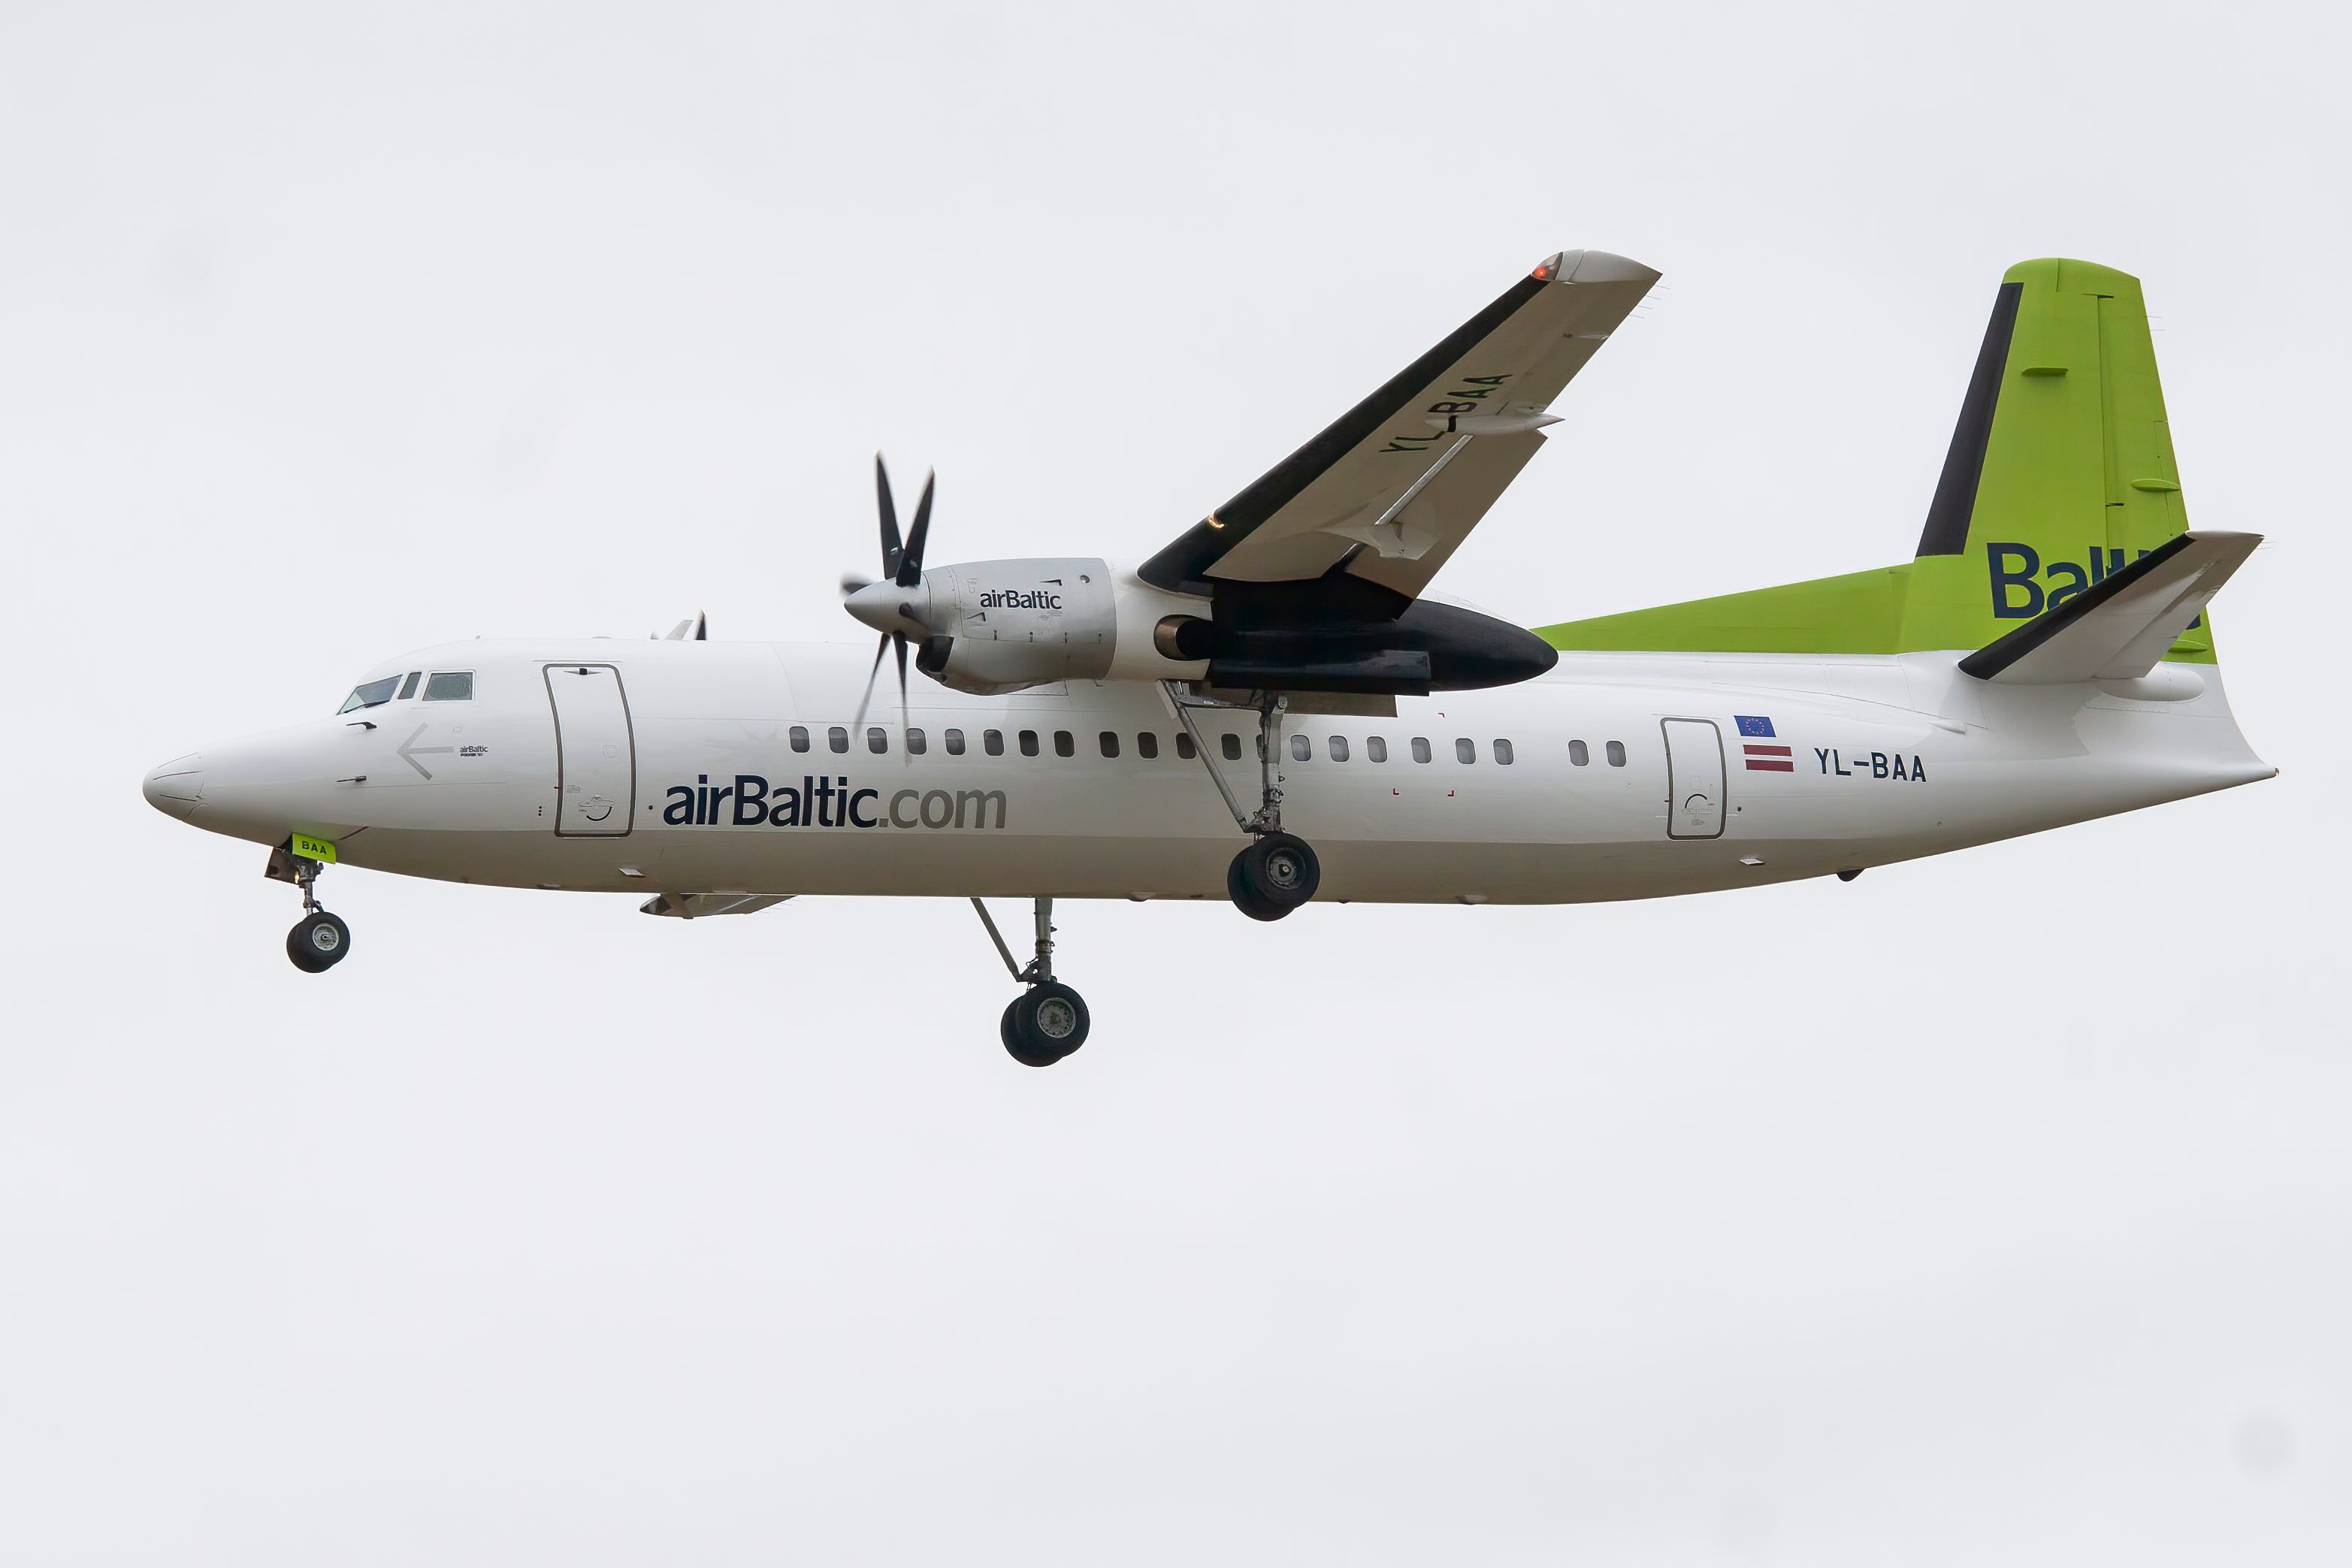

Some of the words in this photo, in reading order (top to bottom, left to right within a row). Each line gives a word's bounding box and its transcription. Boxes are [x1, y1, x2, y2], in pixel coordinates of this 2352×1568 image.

[1379, 374, 1513, 452] YL-BAA
[980, 589, 1063, 610] airBaltic
[1813, 747, 1927, 783] YL-BAA
[663, 774, 1007, 829] airBaltic.com
[301, 841, 327, 855] BAA
